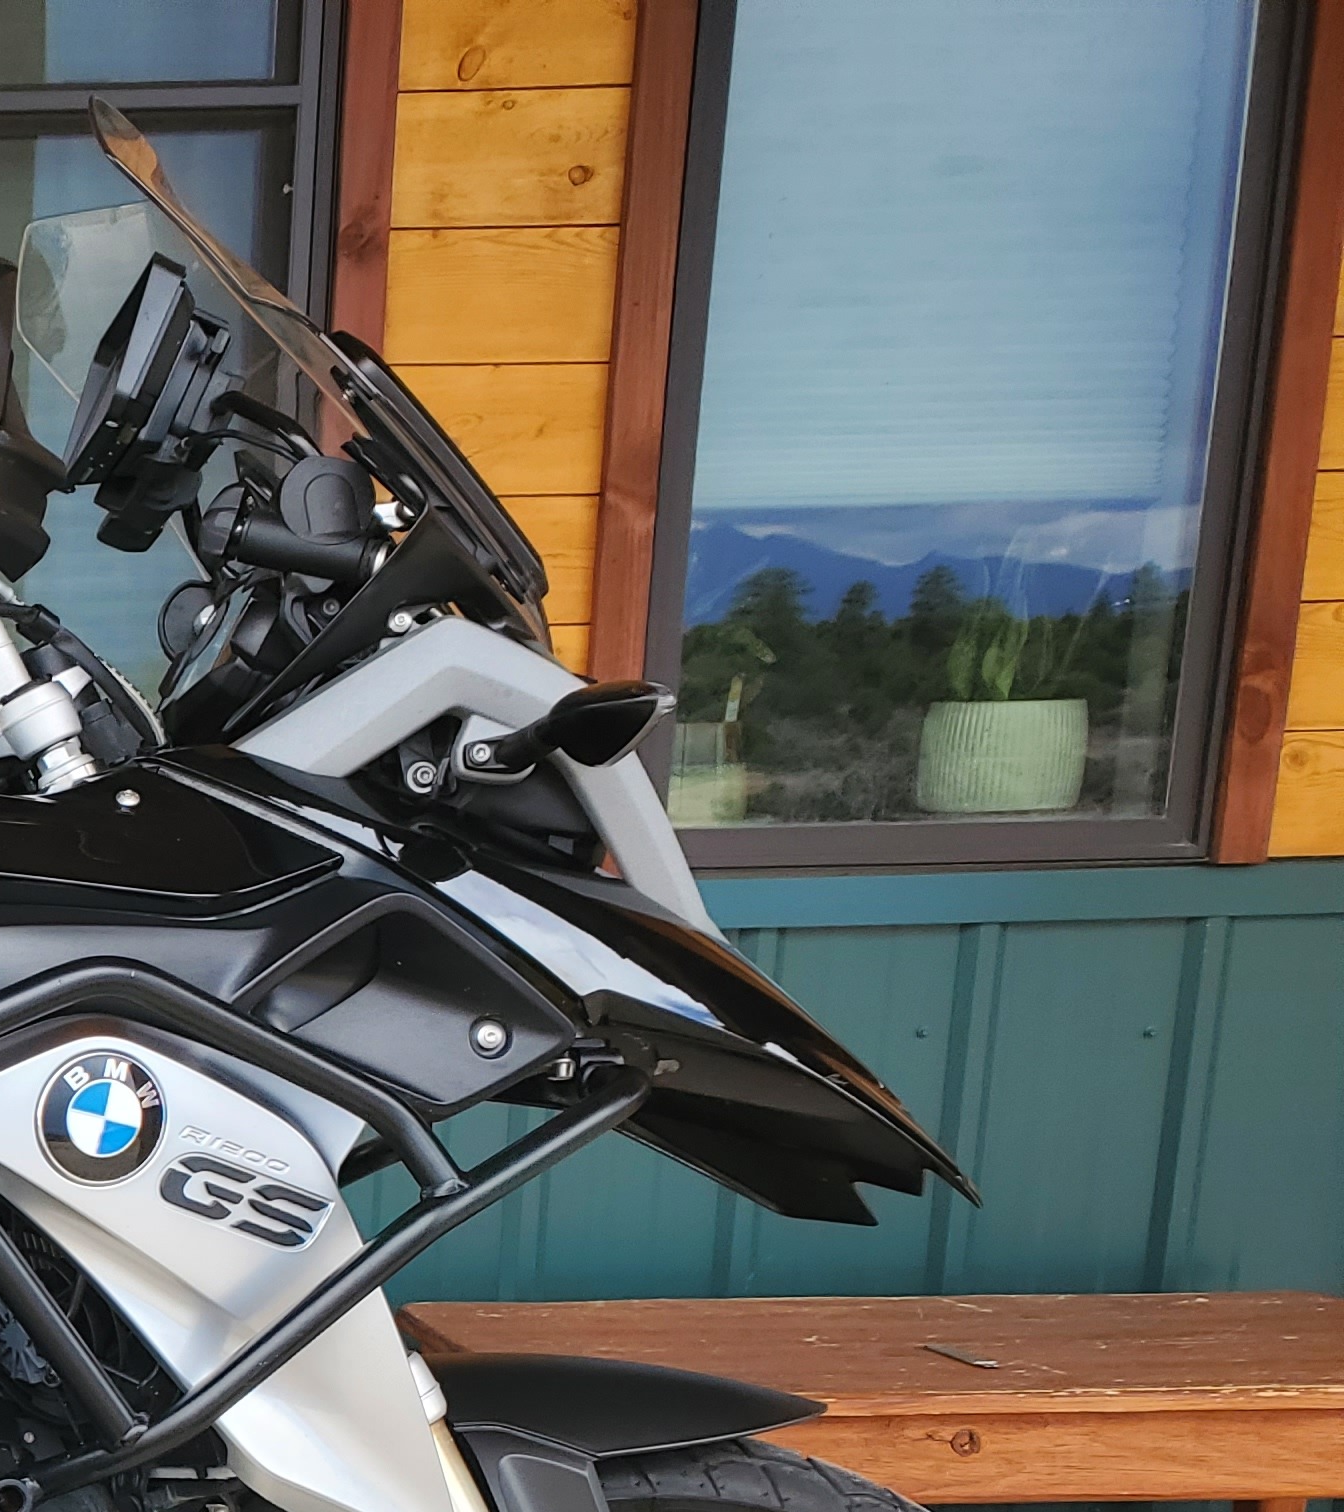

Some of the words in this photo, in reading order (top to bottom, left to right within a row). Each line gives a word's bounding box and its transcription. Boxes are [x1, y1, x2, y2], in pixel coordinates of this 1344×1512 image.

[64, 1058, 159, 1109] BMW
[179, 1124, 291, 1175] R1200
[160, 1156, 329, 1248] GS
